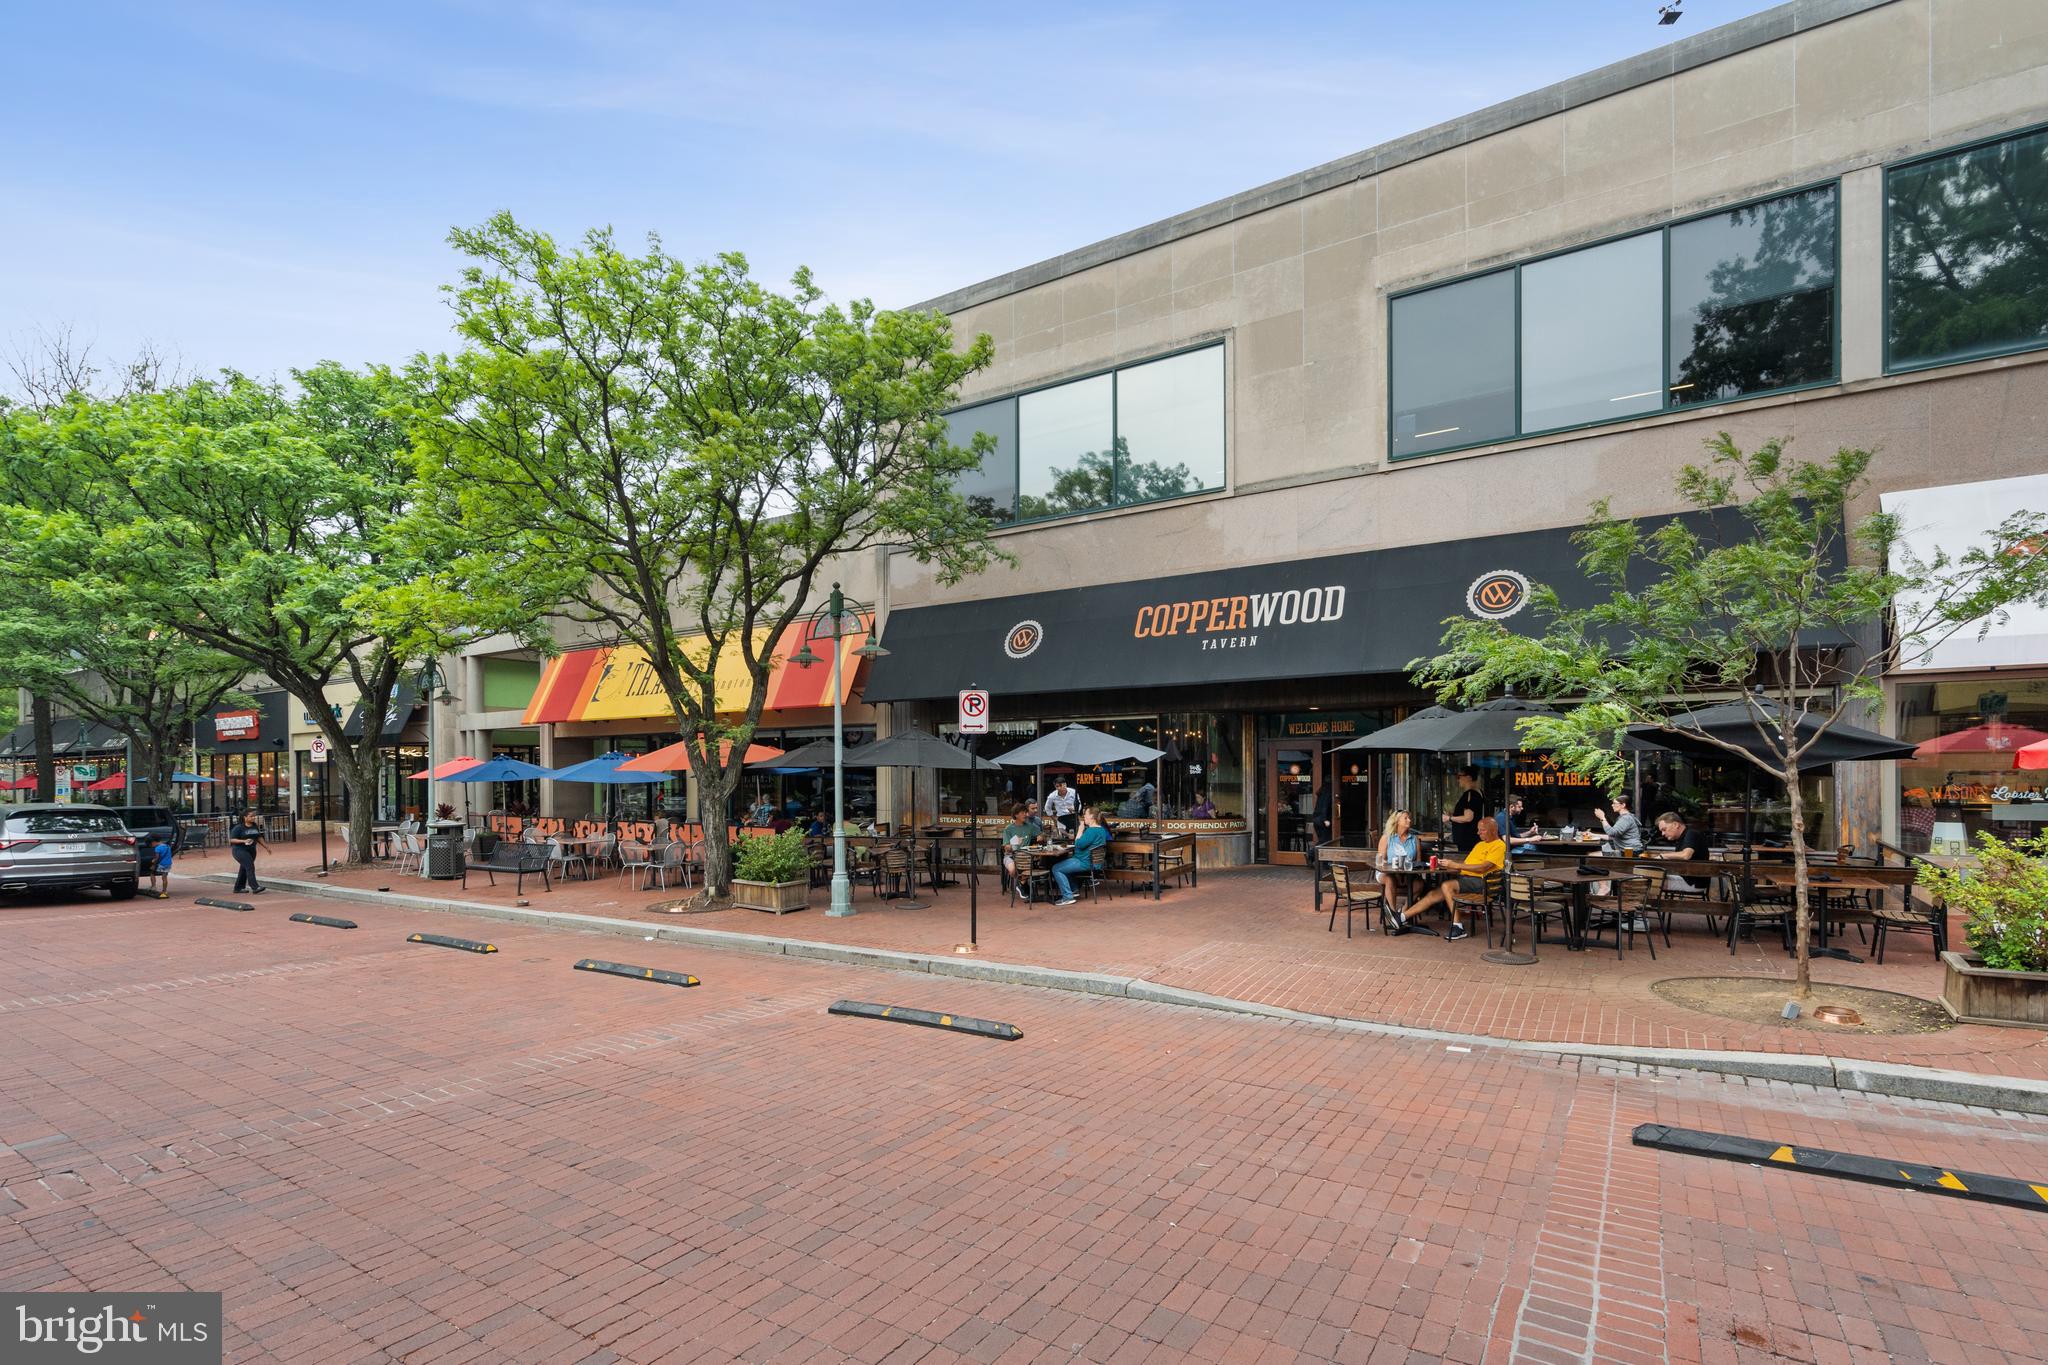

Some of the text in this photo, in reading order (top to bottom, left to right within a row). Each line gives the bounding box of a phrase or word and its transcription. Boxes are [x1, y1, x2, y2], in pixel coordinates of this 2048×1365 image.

[1134, 585, 1346, 638] COPPERWOOD
[1202, 635, 1258, 650] TAVERN
[1288, 720, 1355, 735] WELCOME HOME
[1076, 773, 1094, 785] FARM
[1101, 773, 1123, 785] TABLE
[1515, 772, 1544, 786] FARM
[1556, 772, 1591, 786] TABLE
[1991, 785, 2041, 801] Lobster
[1167, 822, 1186, 830] DOG
[1188, 822, 1229, 830] FRIENDLY
